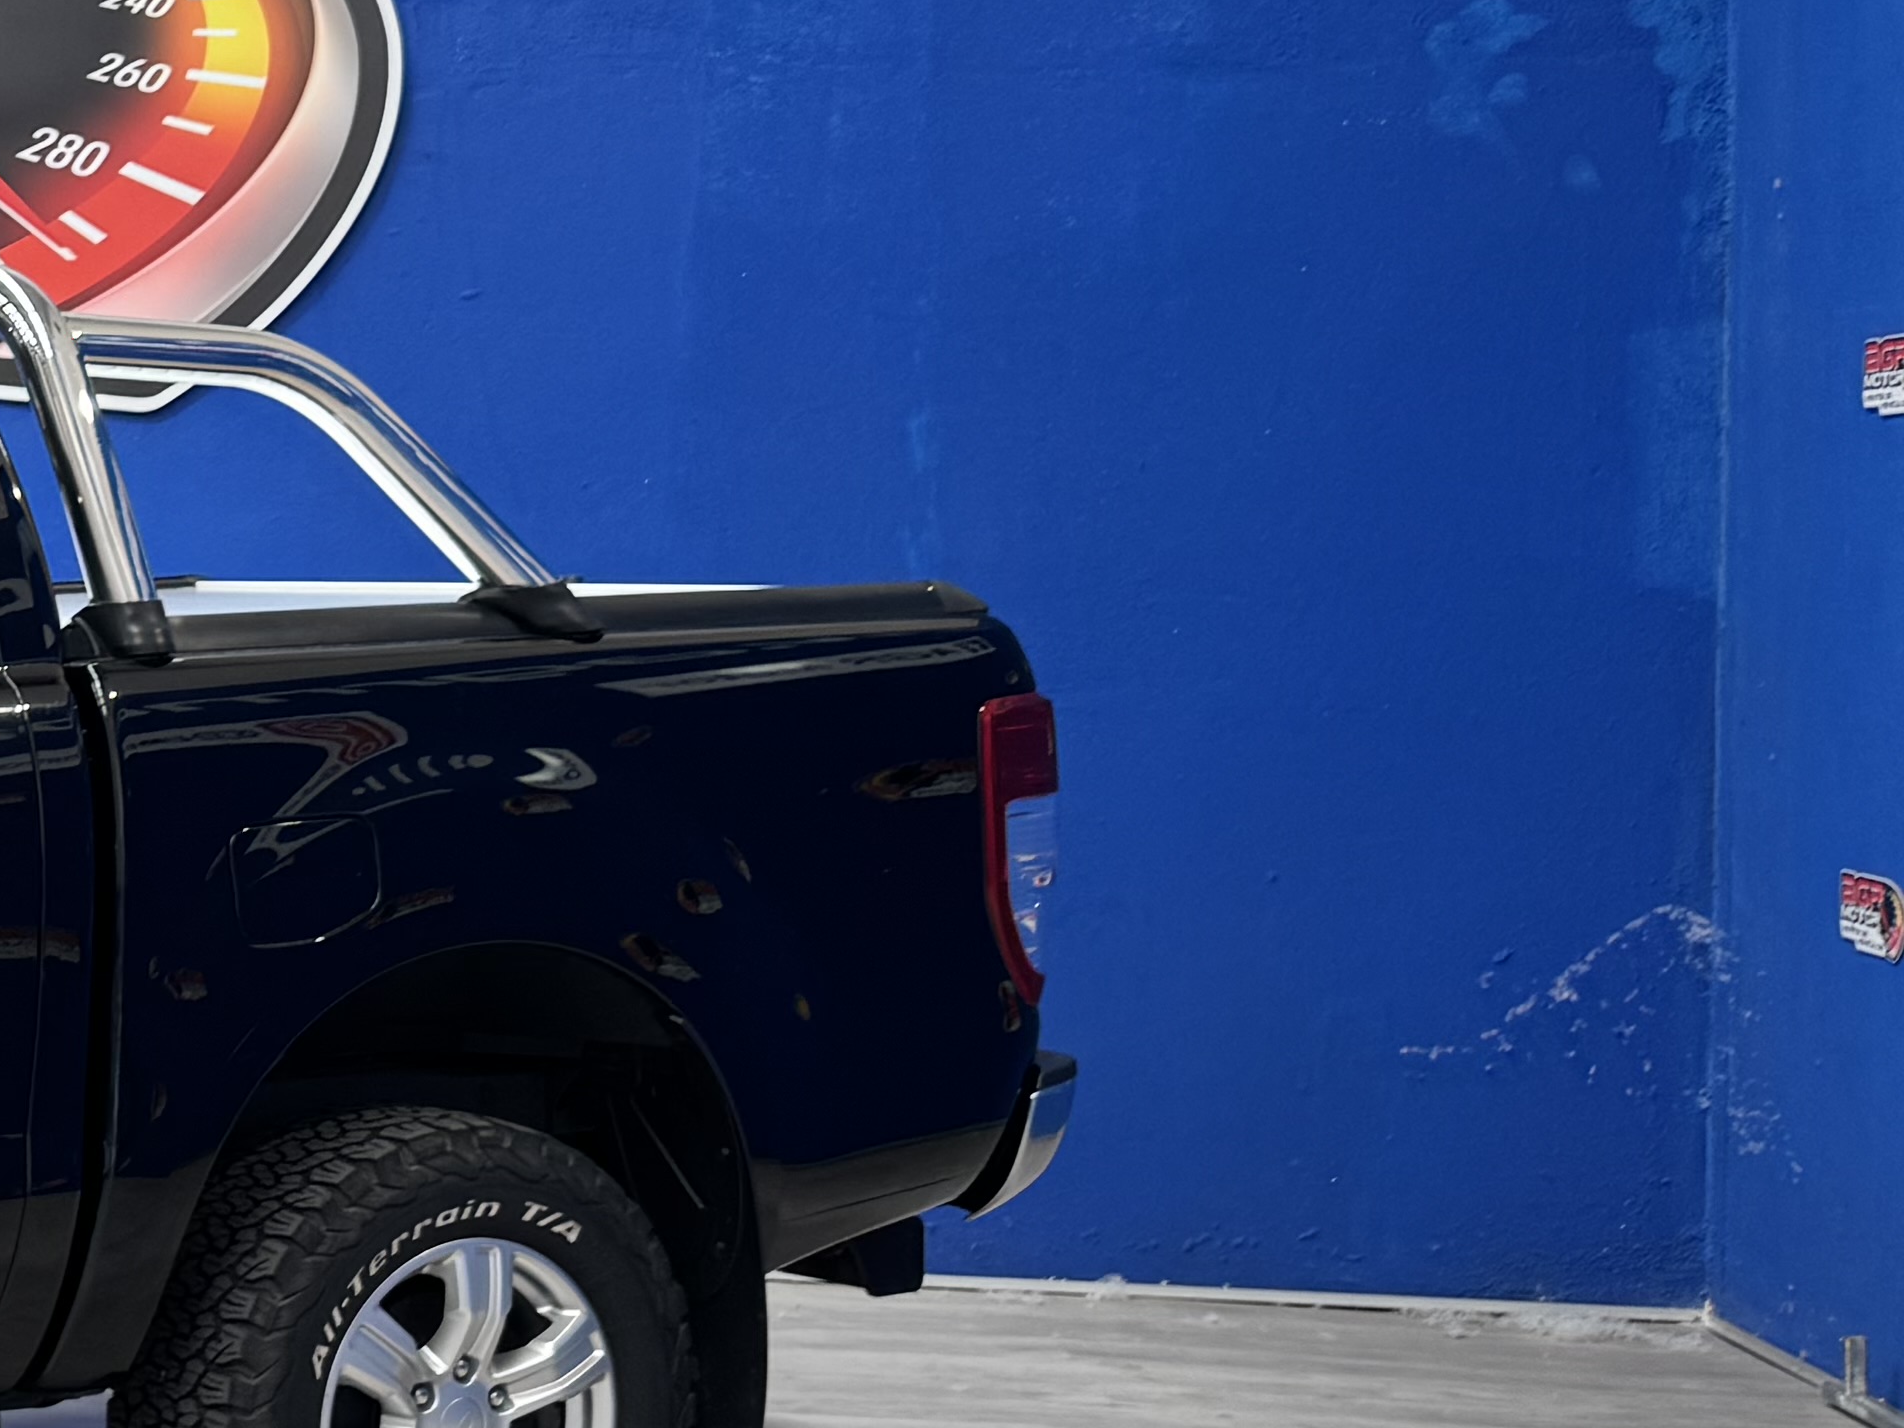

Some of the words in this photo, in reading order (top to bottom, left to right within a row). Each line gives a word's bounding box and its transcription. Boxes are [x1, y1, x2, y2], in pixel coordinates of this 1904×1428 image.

[86, 53, 173, 94] 260
[15, 127, 111, 178] 280
[309, 1198, 500, 1381] All-Terrain
[520, 1199, 584, 1245] T/A
